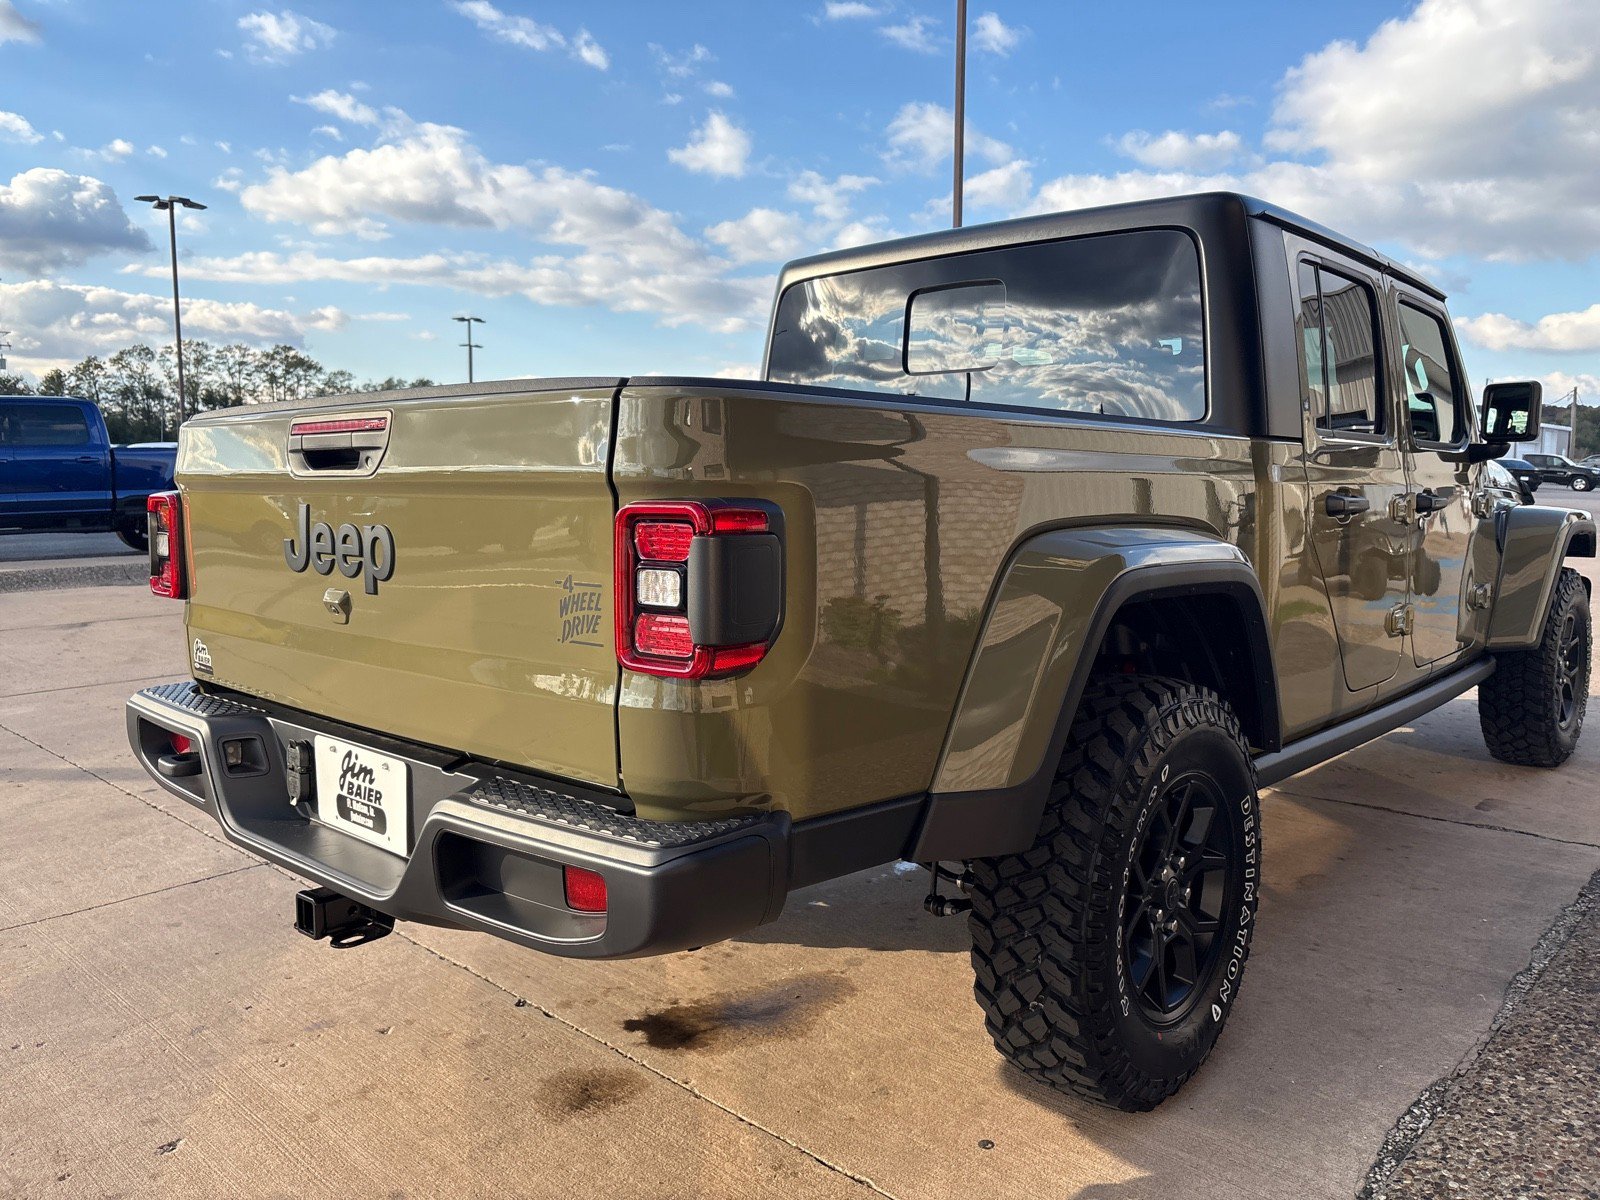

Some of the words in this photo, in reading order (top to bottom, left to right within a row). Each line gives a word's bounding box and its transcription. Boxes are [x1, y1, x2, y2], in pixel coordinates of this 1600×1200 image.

[283, 503, 396, 595] Jeep
[562, 574, 573, 593] 4
[559, 591, 602, 618] WHEEL
[561, 614, 602, 643] DRIVE
[338, 749, 376, 792] Jim
[346, 780, 383, 806] BAIER
[1219, 794, 1257, 1003] DESTINATION
